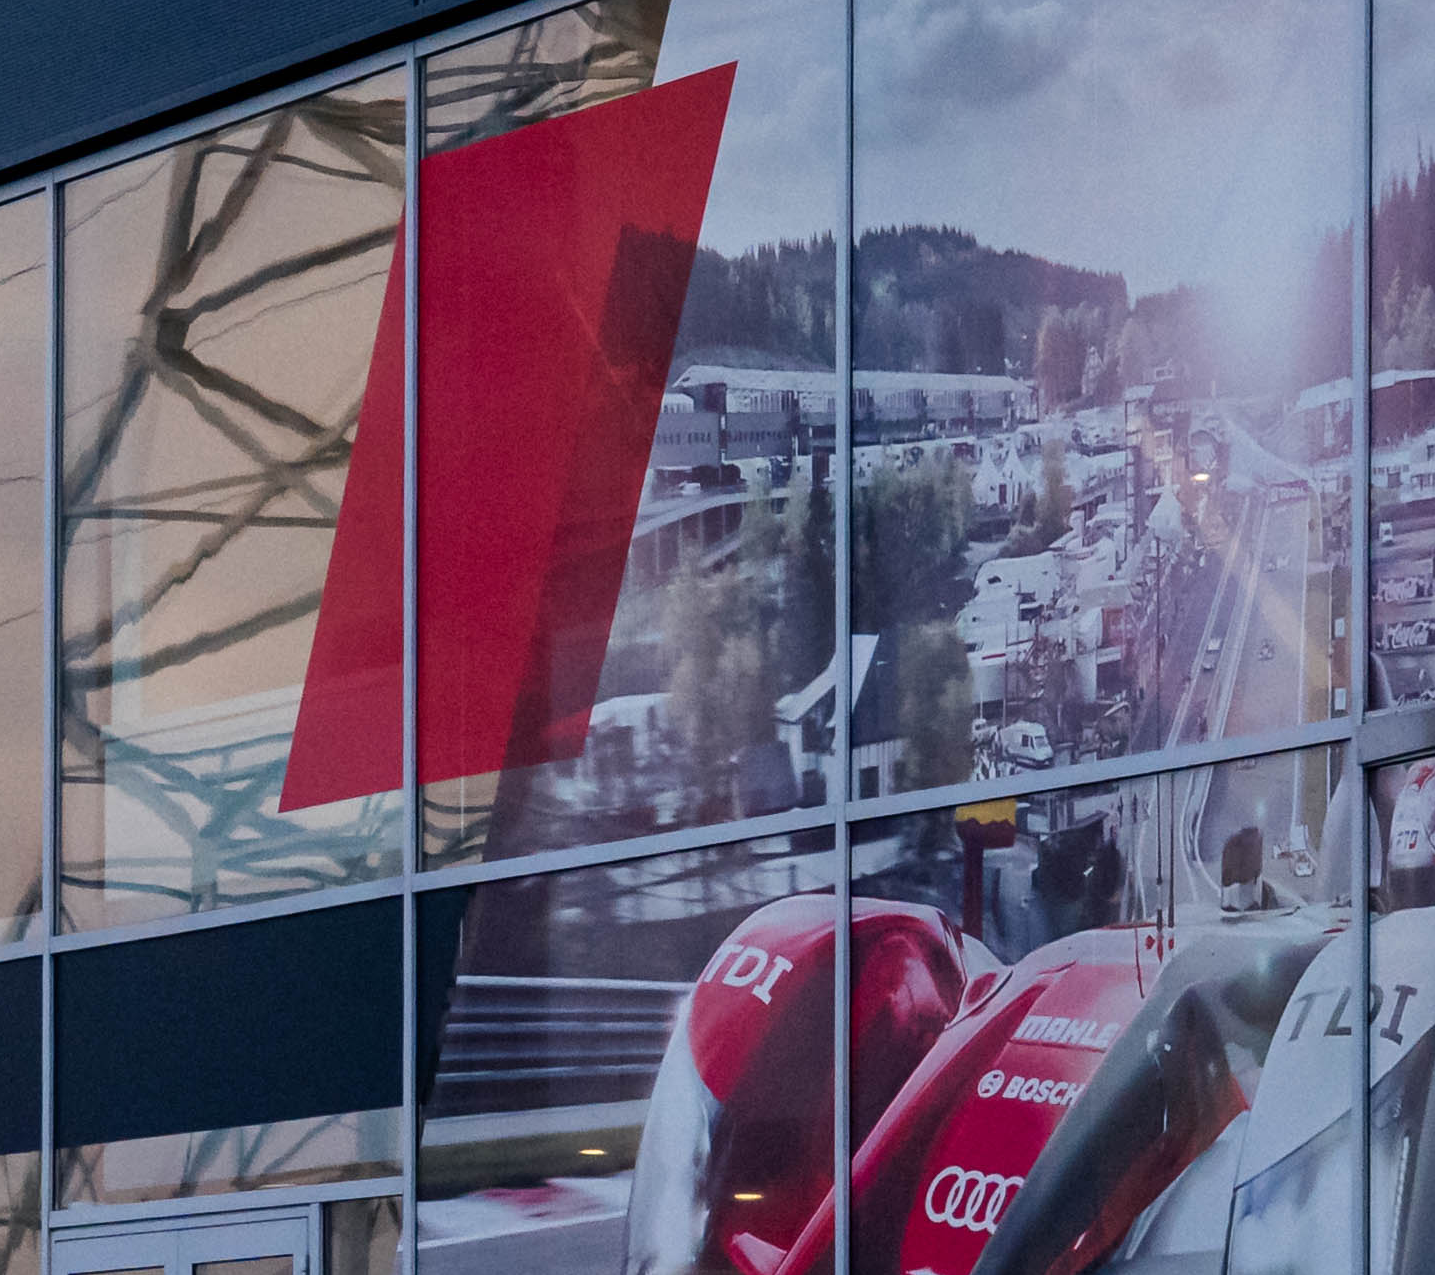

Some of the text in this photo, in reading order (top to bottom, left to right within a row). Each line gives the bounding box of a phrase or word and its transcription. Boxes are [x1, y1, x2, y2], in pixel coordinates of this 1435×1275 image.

[702, 943, 794, 1006] TDI
[1287, 983, 1419, 1046] TDI
[1002, 1074, 1087, 1107] BOSCH
